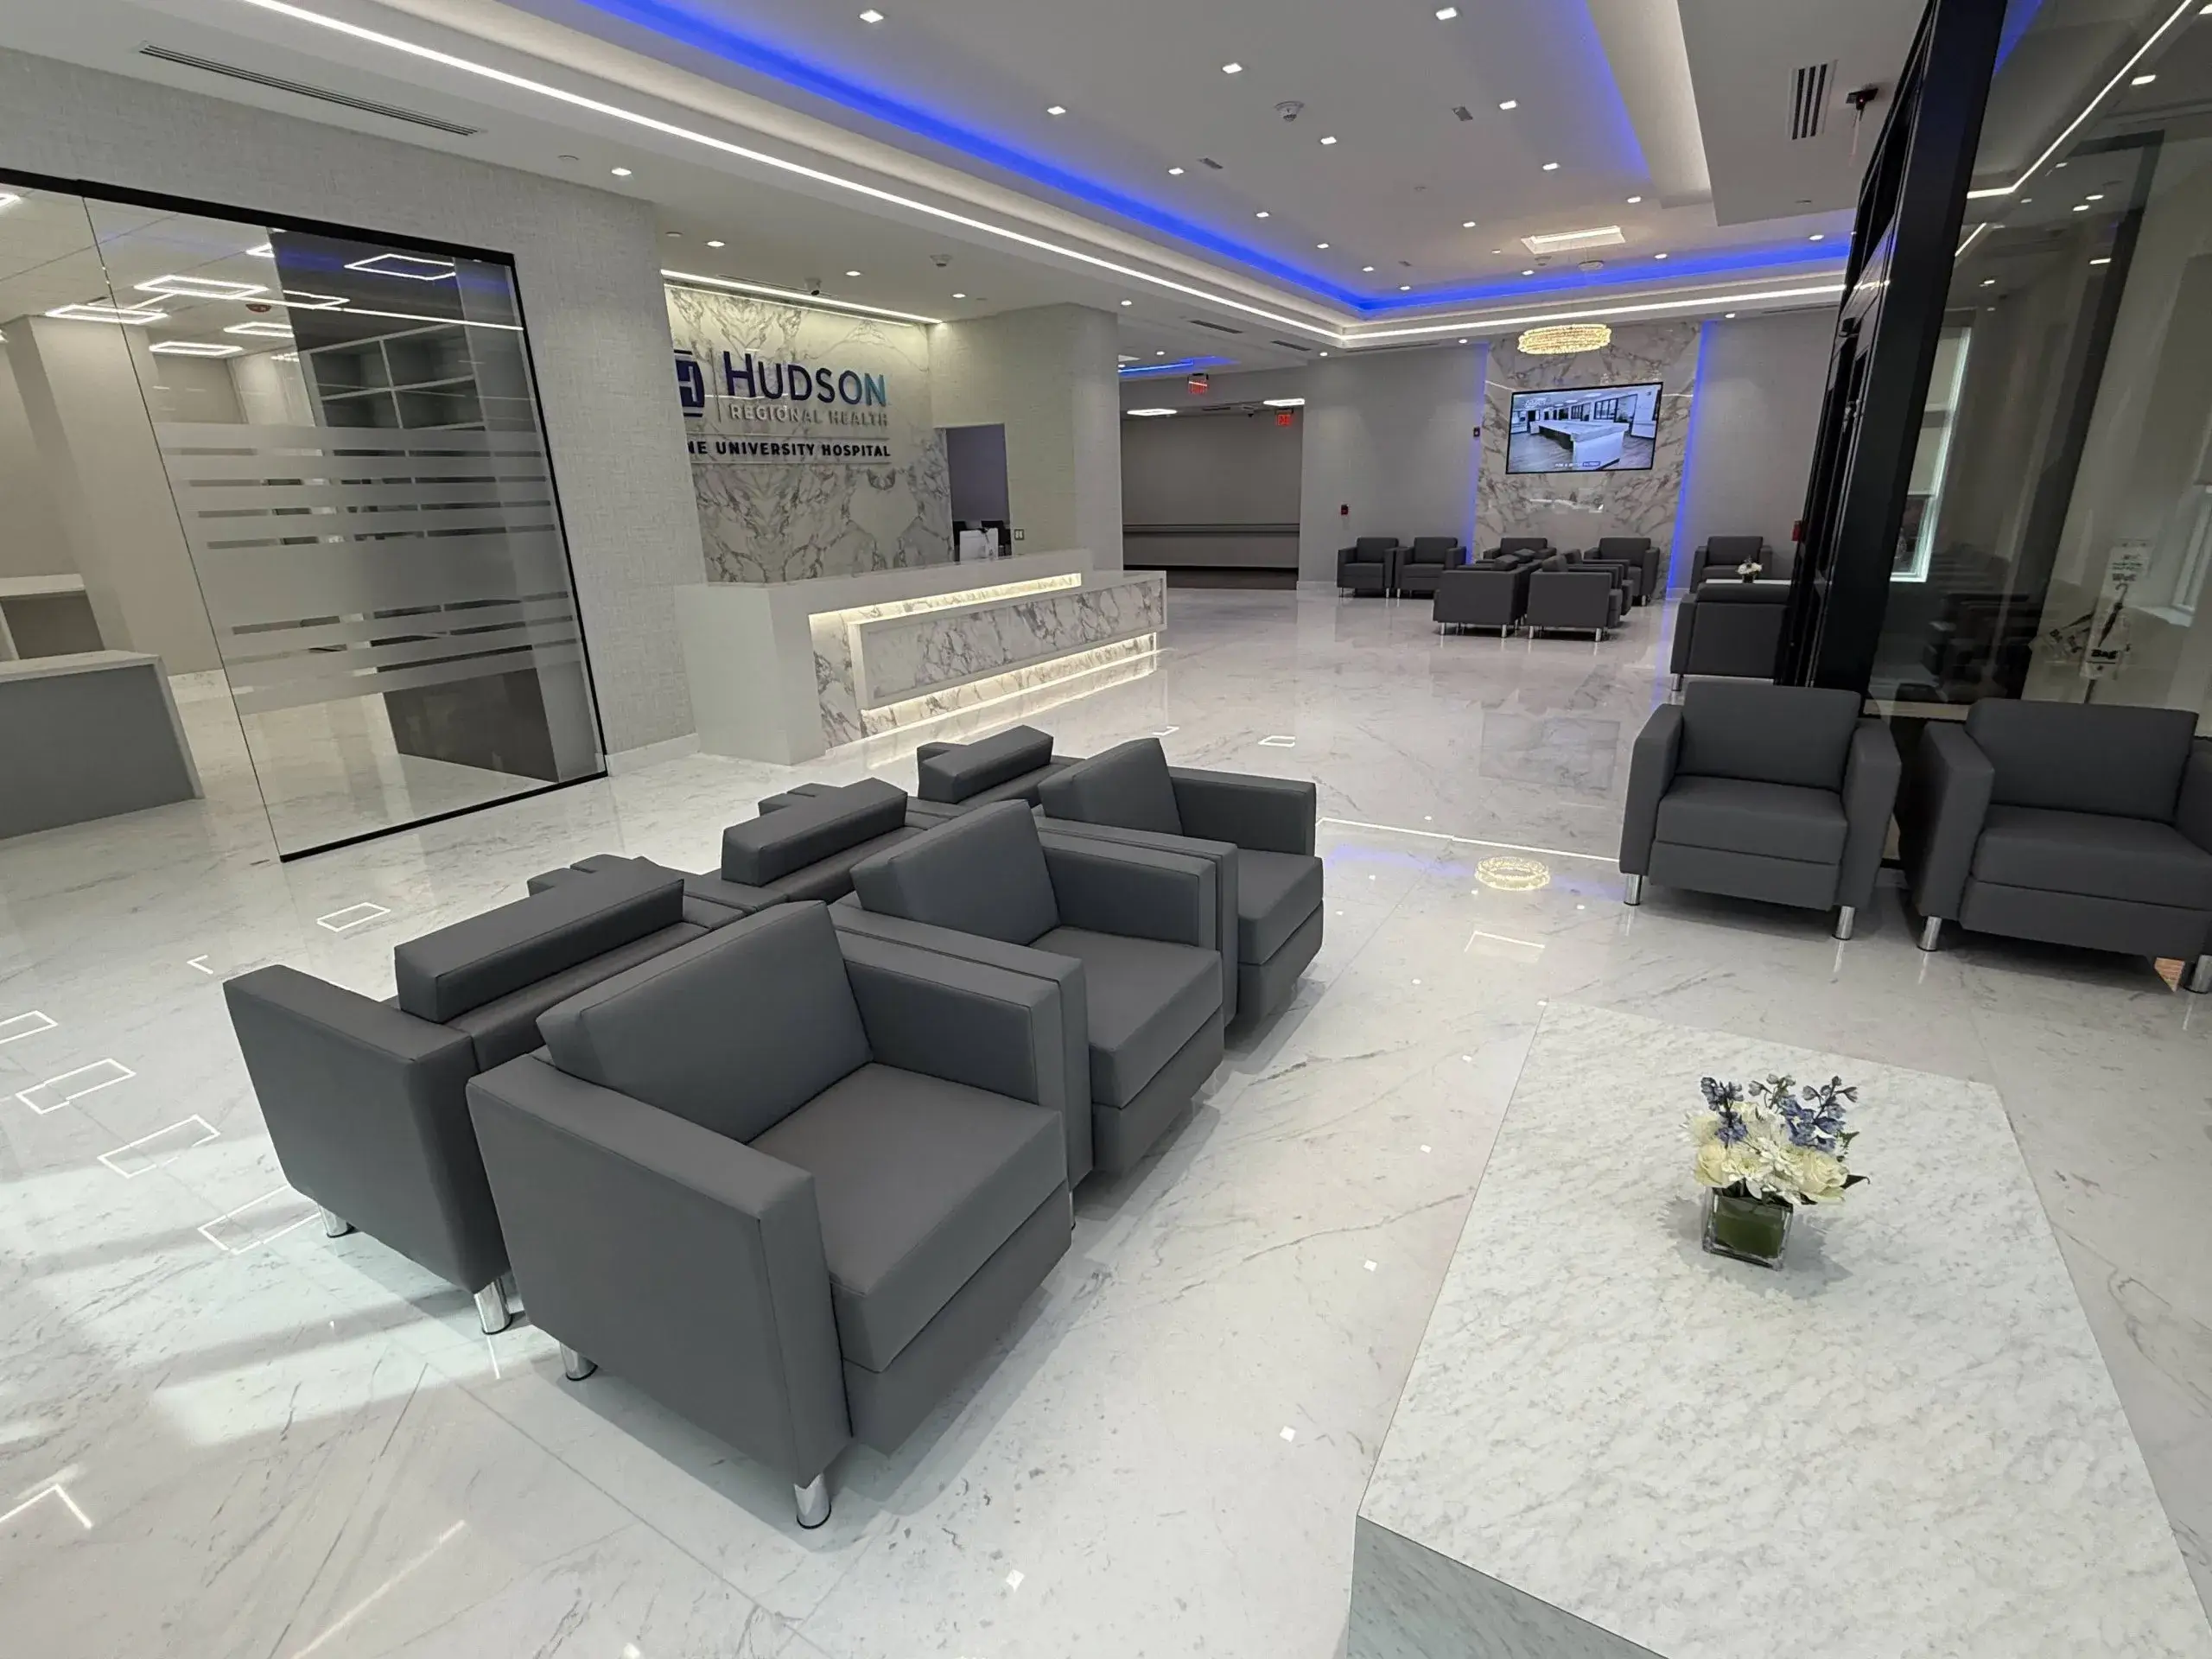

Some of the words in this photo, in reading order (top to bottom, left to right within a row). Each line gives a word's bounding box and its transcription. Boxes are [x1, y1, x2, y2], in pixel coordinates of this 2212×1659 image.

[723, 351, 887, 406] HUDSON
[729, 404, 823, 424] REGIONAL
[829, 410, 888, 427] HEALTH
[715, 441, 815, 456] UNIVERSITY
[822, 444, 891, 457] HOSPITAL
